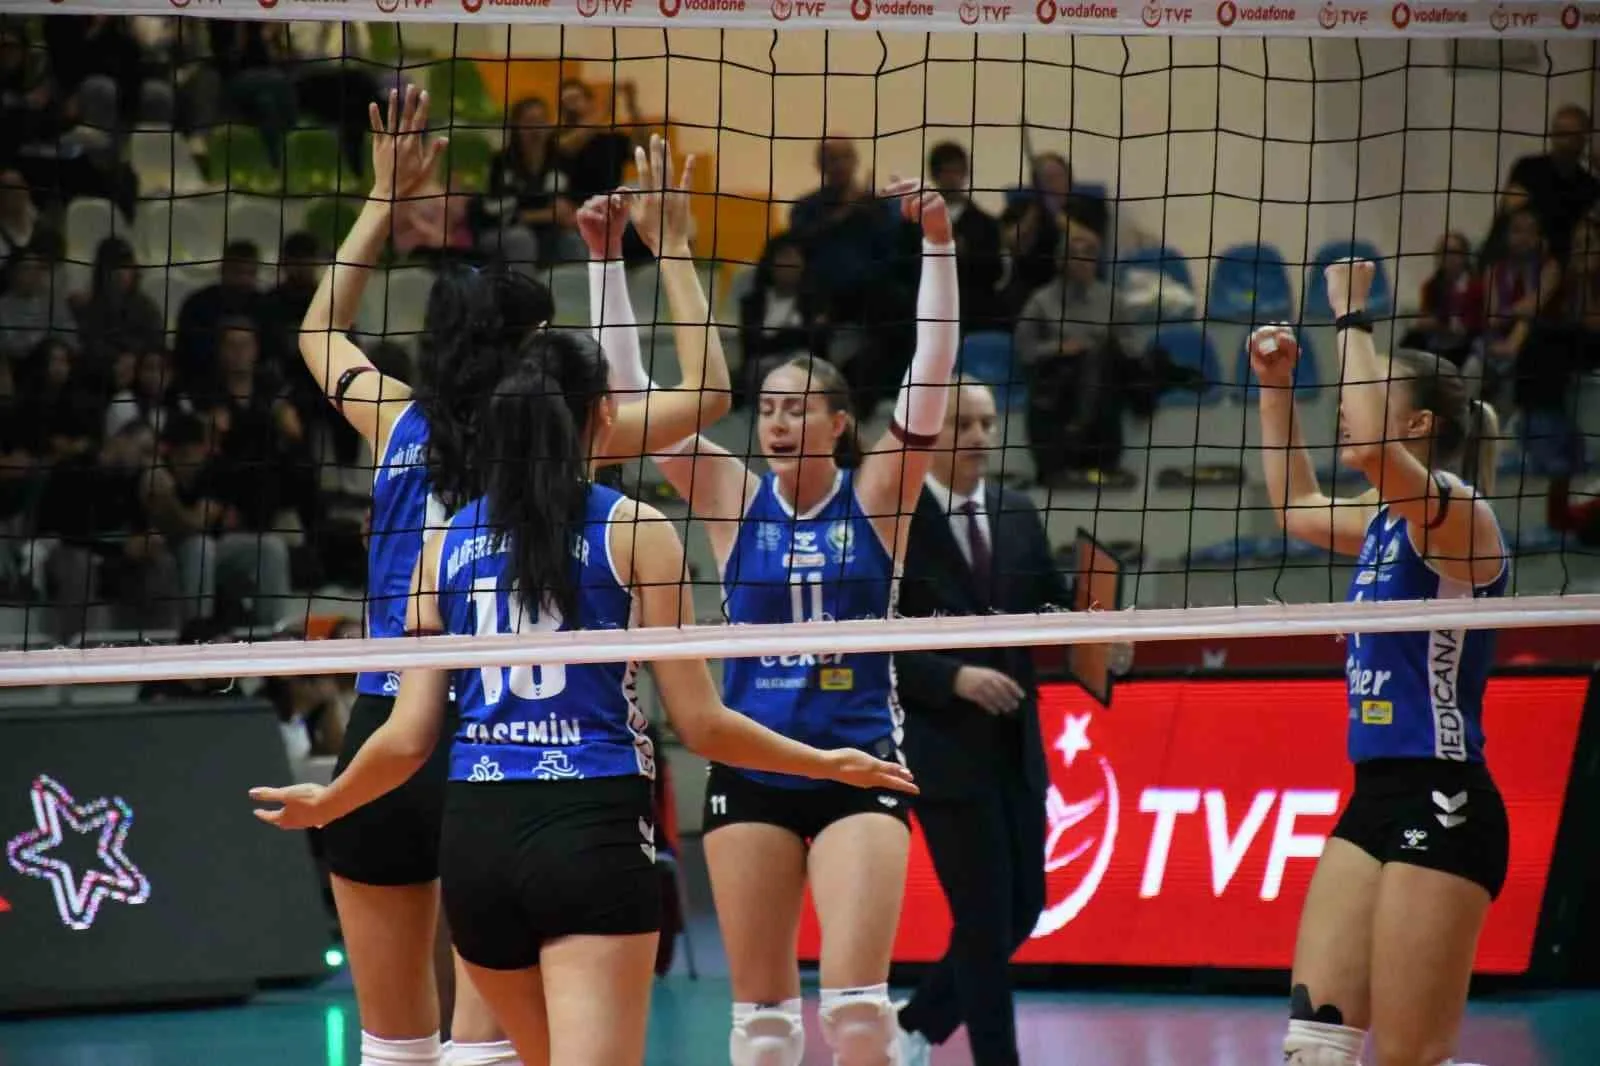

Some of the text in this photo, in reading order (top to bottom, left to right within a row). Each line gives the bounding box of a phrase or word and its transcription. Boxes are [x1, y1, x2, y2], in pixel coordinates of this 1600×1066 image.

[602, 0, 634, 14] TVF
[684, 0, 746, 11] vodafone
[795, 1, 827, 18] TVF
[875, 1, 935, 16] vodafone
[982, 5, 1013, 21] TVF
[1060, 4, 1118, 19] vodafone
[1164, 7, 1193, 24] TVF
[1239, 6, 1296, 22] vodafone
[1340, 10, 1369, 26] TVF
[1412, 8, 1468, 24] vodafone
[1511, 13, 1539, 28] TVF
[710, 794, 727, 816] 11
[1137, 786, 1341, 902] TVF
